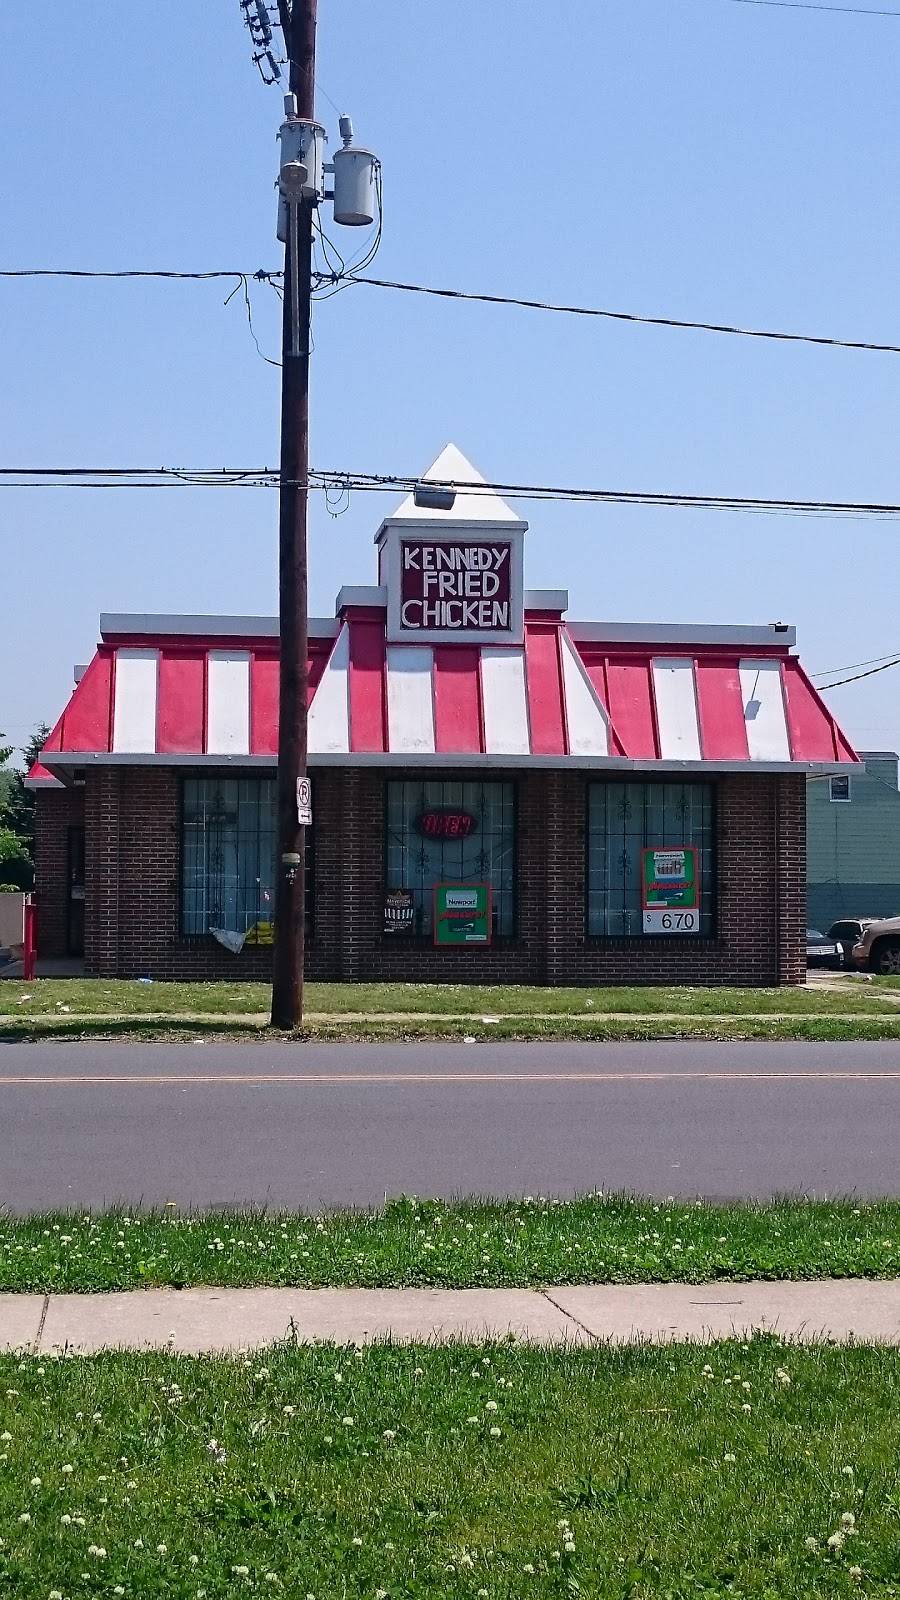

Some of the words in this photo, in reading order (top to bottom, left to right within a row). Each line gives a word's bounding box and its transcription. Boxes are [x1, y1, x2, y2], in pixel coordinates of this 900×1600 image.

[404, 547, 509, 570] KENNEDY
[423, 571, 500, 598] FRIED
[401, 599, 508, 628] CHICKEN
